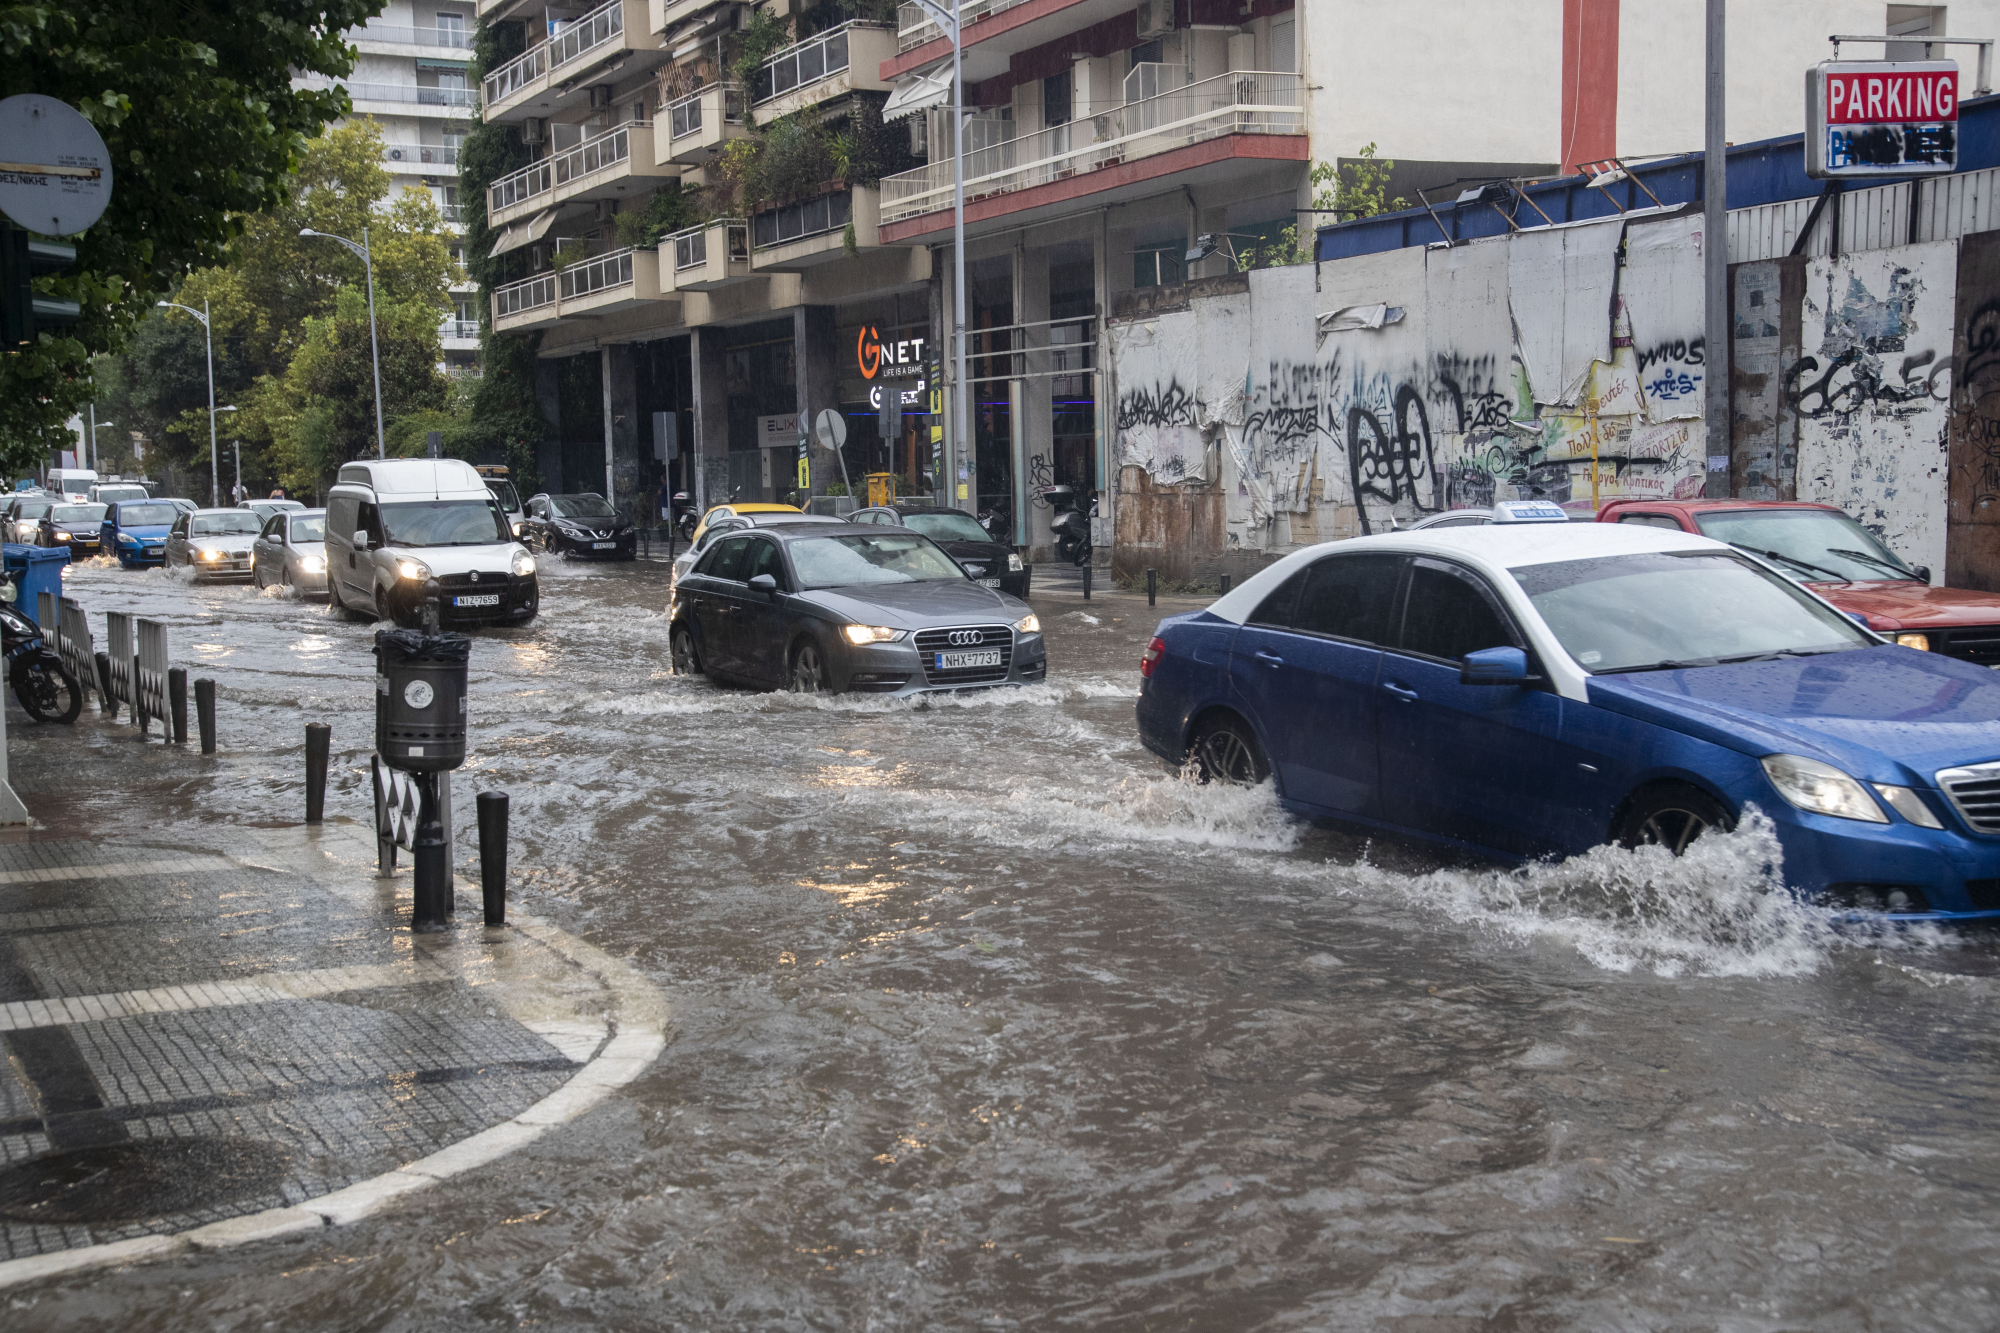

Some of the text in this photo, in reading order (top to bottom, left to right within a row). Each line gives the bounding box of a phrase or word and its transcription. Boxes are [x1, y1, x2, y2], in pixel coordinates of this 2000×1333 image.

[1831, 77, 1953, 118] PARKING
[884, 365, 923, 377] LIFE IS A GAME
[1582, 468, 1619, 488] Γιργος
[459, 595, 498, 605] NIZ-7659
[945, 652, 999, 667] NHX-7737
